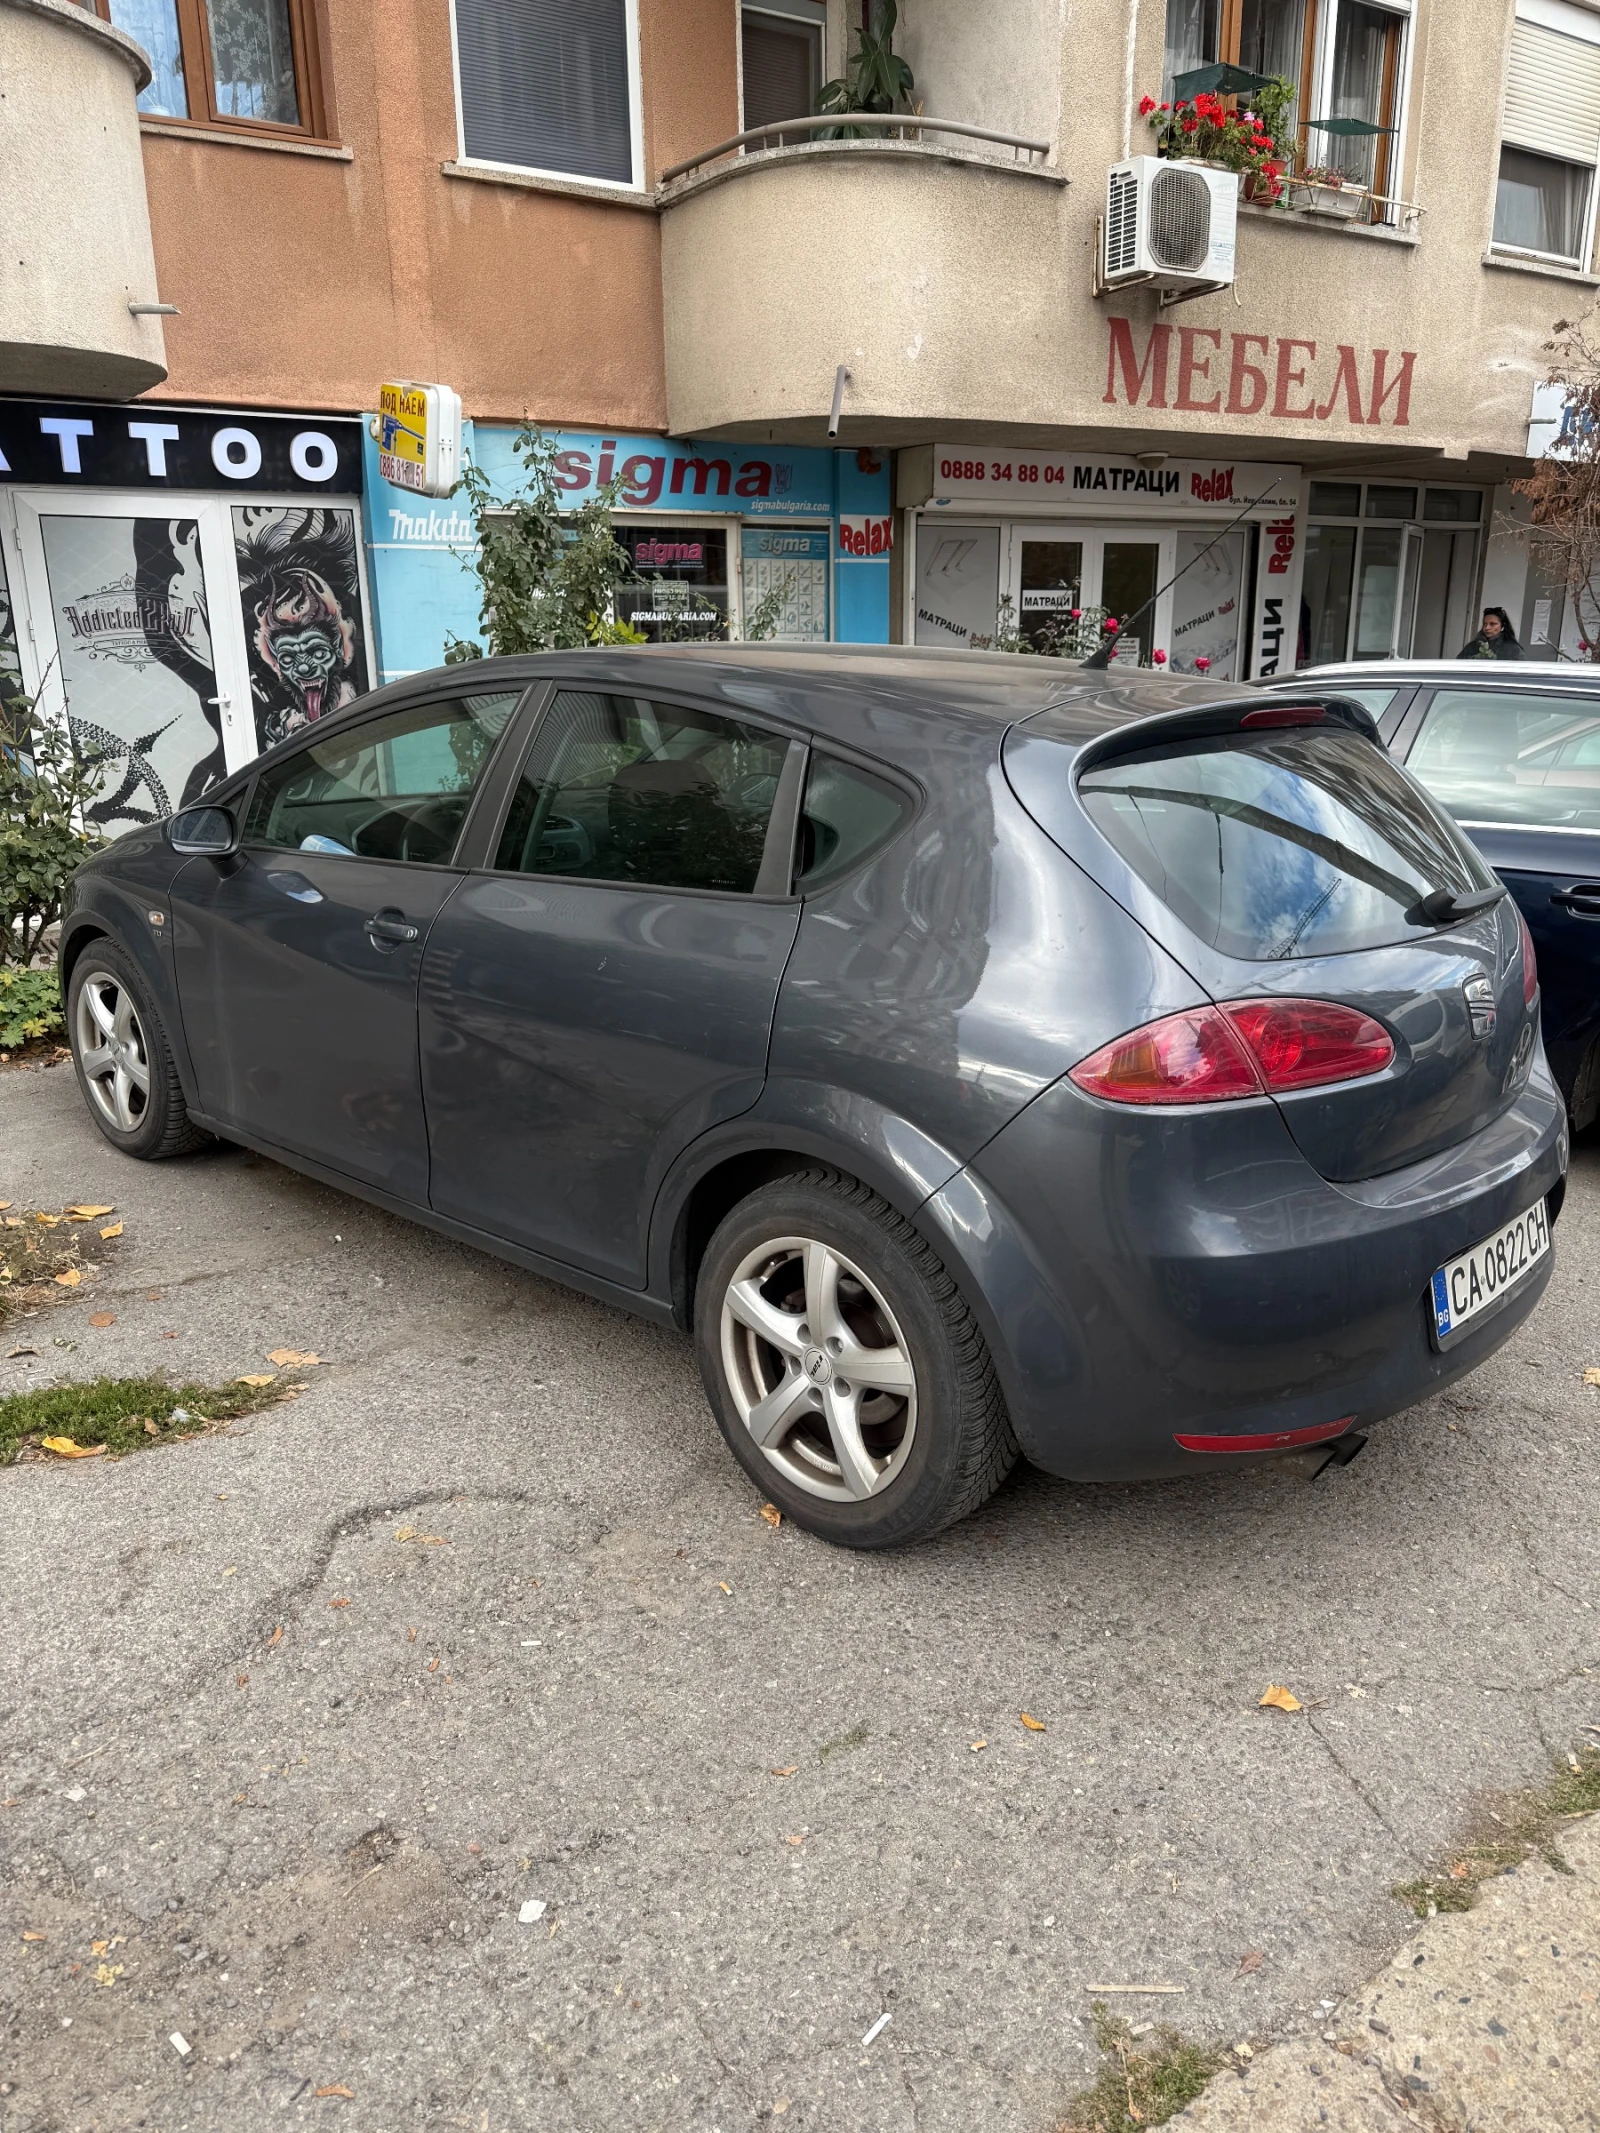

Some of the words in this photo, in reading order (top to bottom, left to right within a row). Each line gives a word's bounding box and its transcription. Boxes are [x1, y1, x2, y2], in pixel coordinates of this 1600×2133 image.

[1102, 316, 1418, 426] МЕБЕЛИ
[381, 390, 397, 415] ПОД
[400, 394, 425, 417] НАЕМ
[0, 417, 338, 482] TTOO
[552, 440, 772, 506] sigma
[941, 459, 985, 480] 0888
[990, 462, 1012, 482] 34
[1018, 464, 1039, 483] 88
[1044, 466, 1065, 484] 04
[1073, 465, 1180, 497] МАТРАЦИ
[1191, 466, 1235, 502] Relax
[751, 499, 830, 513] sigmabulgaria.com
[635, 537, 703, 565] sigma
[759, 533, 811, 556] sigma
[839, 516, 894, 556] Relax
[1024, 596, 1070, 608] МАТРАЦИ
[918, 608, 968, 639] МАТРАЦИ
[1174, 609, 1215, 638] МАТРАЦИ
[1437, 1308, 1449, 1327] BG
